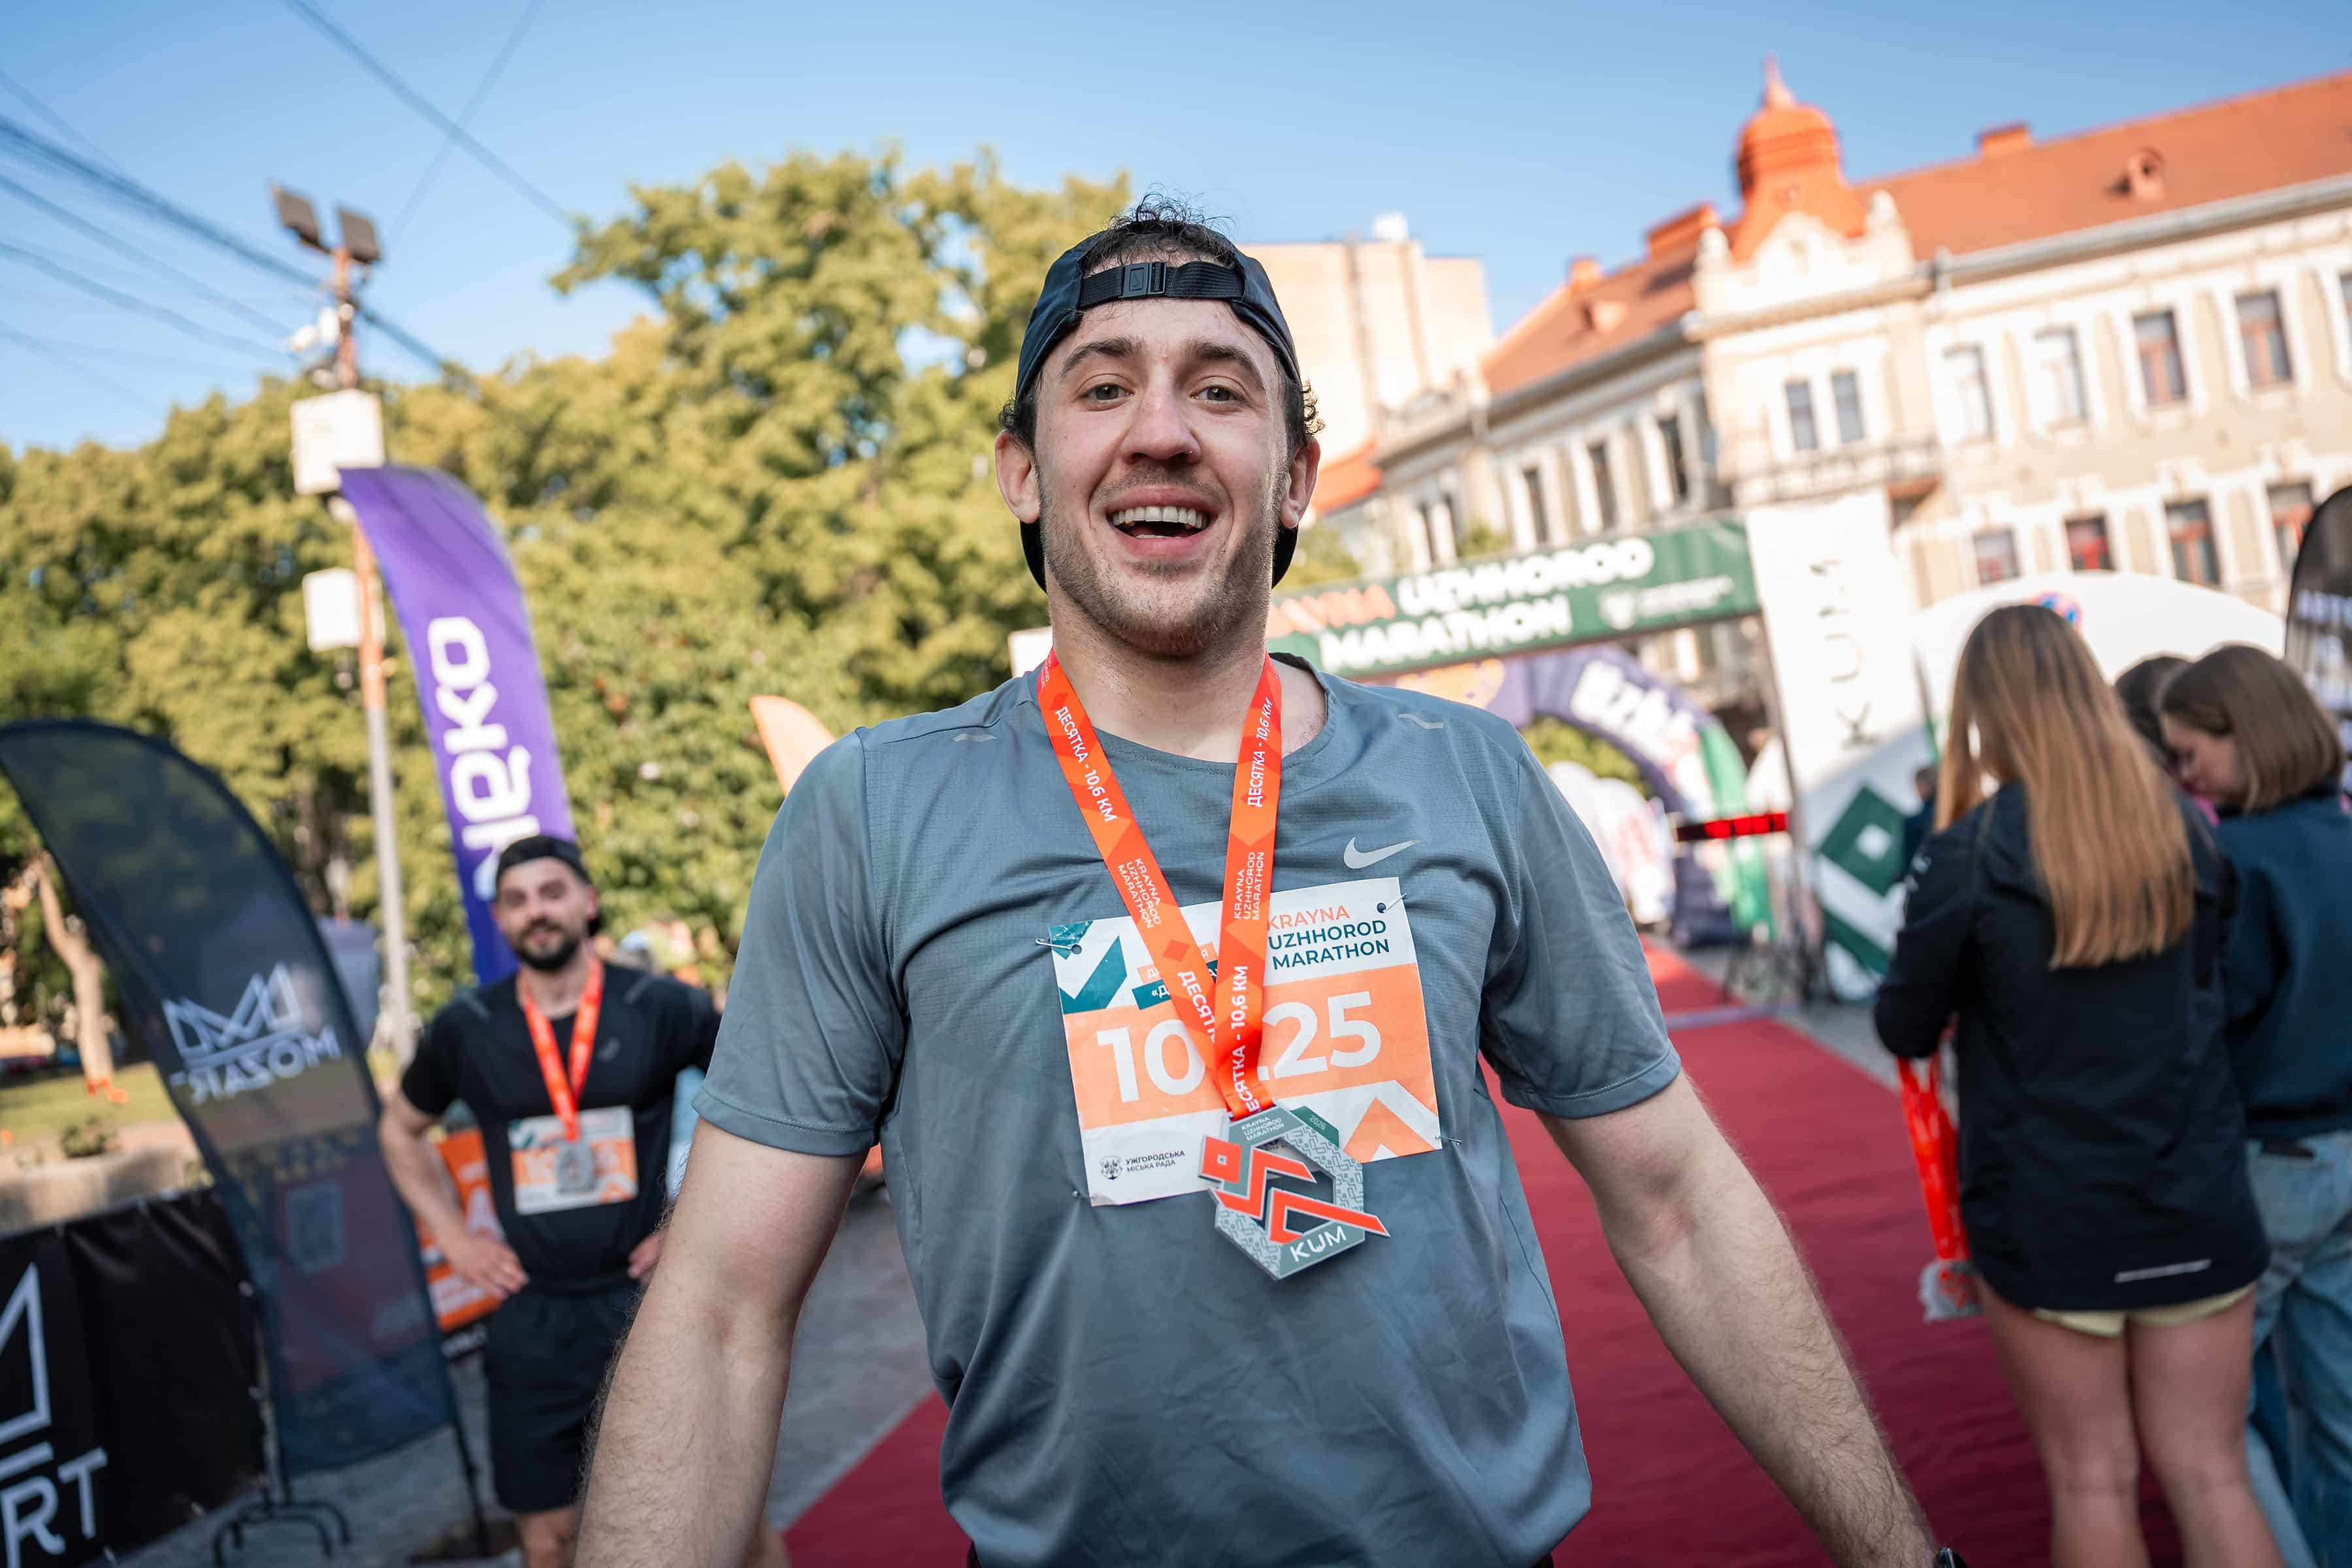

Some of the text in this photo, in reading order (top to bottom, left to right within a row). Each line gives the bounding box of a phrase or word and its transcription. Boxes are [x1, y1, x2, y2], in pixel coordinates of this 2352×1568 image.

[1256, 717, 1270, 740] 10,6
[1055, 706, 1088, 763] ДЕСЯТКА
[1085, 769, 1105, 796] 10,6
[1247, 751, 1266, 808] ДЕСЯТКА
[1118, 864, 1154, 928] MARATHON
[1126, 862, 1160, 924] UZHHOROD
[1135, 858, 1160, 904] KRAYNA
[1233, 869, 1245, 919] KRAYNA
[1243, 852, 1255, 919] UZHHOROD
[1252, 852, 1265, 920] MARATHON
[1268, 905, 1350, 930] KRAYNA
[1268, 920, 1386, 949] UZHHOROD
[1273, 939, 1390, 970] MARATHON
[1231, 994, 1247, 1029] 10,6
[1096, 991, 1382, 1103] 1025
[1232, 1045, 1260, 1112] ЕСЯТКА
[1241, 1117, 1270, 1130] KRAYNA
[1243, 1118, 1282, 1135] UZHHOROD
[1246, 1124, 1284, 1141] MARATHON
[1126, 1150, 1185, 1165] УЖГОРОДСЬКА
[1127, 1159, 1175, 1173] МІСЬКА РАДА
[1290, 1225, 1347, 1262] KUM
